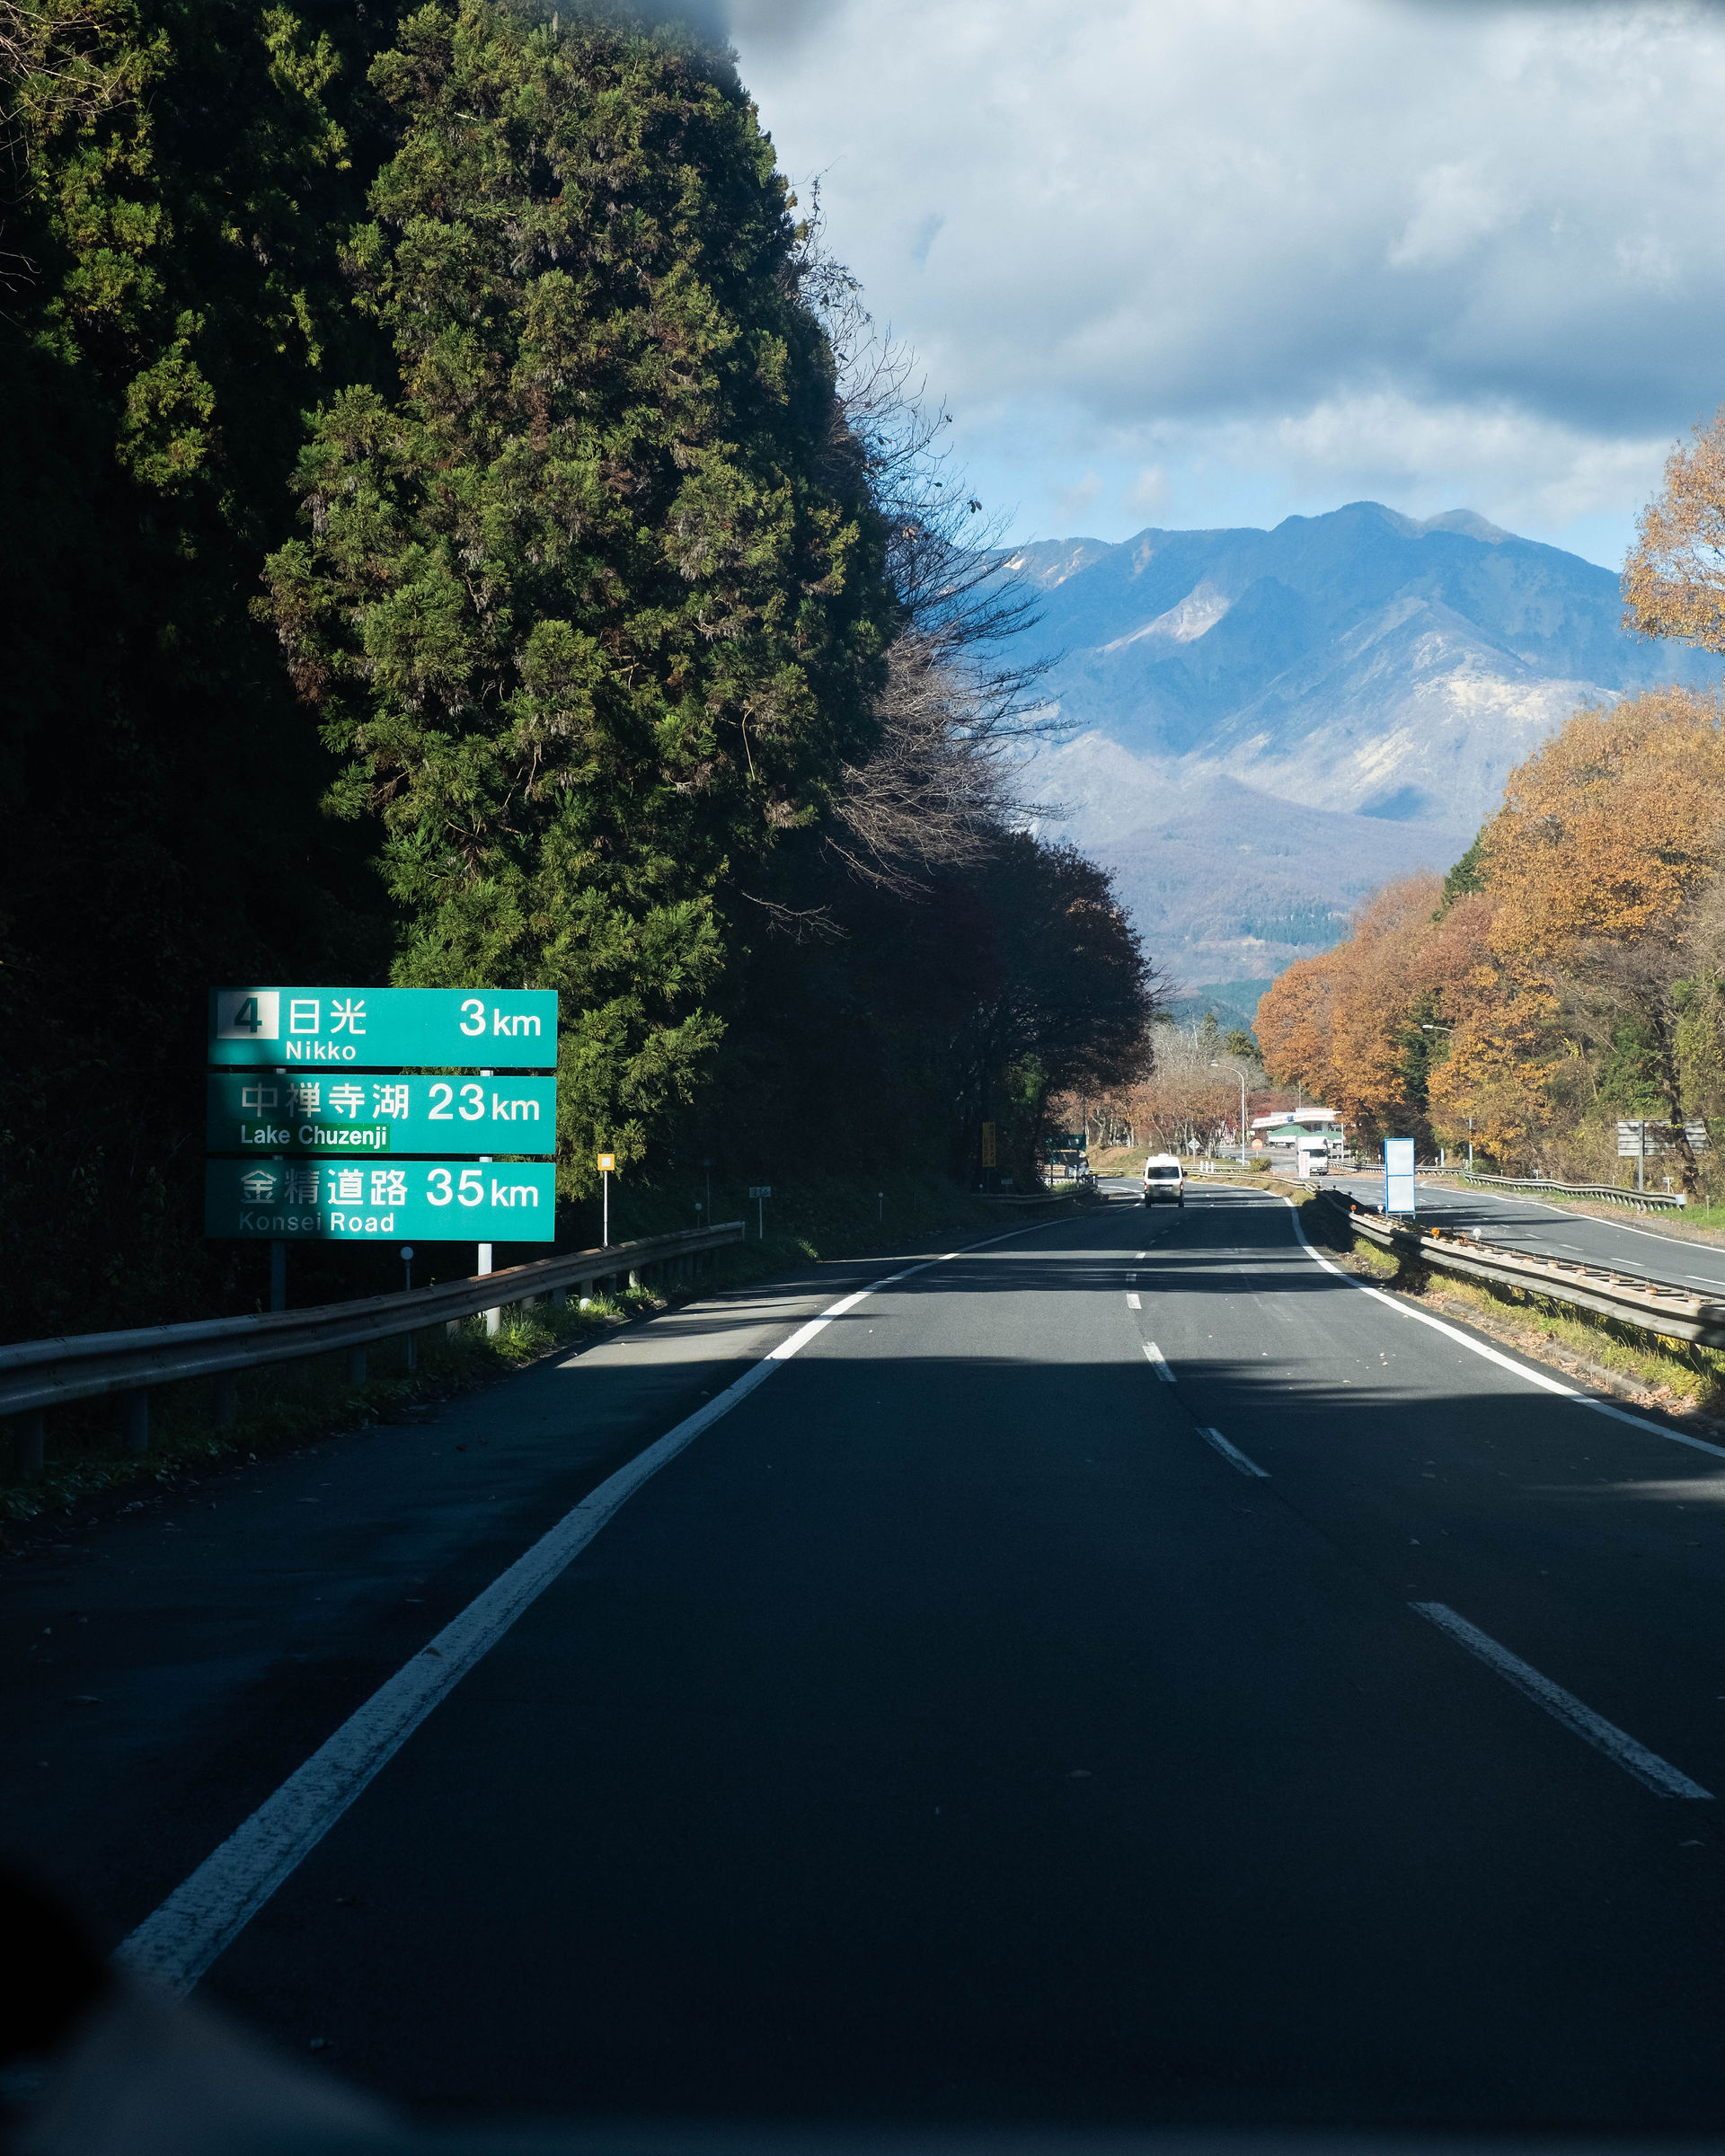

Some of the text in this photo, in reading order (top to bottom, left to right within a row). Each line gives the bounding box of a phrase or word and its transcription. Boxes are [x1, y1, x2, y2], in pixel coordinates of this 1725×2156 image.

[234, 997, 262, 1033] 4
[290, 999, 367, 1035] 日光
[286, 1040, 356, 1060] Nikko
[242, 1082, 409, 1119] 中禅寺湖
[241, 1126, 386, 1150] Lake Chuzenji
[240, 1169, 408, 1206] 金精道路
[239, 1211, 394, 1233] Konsei Road
